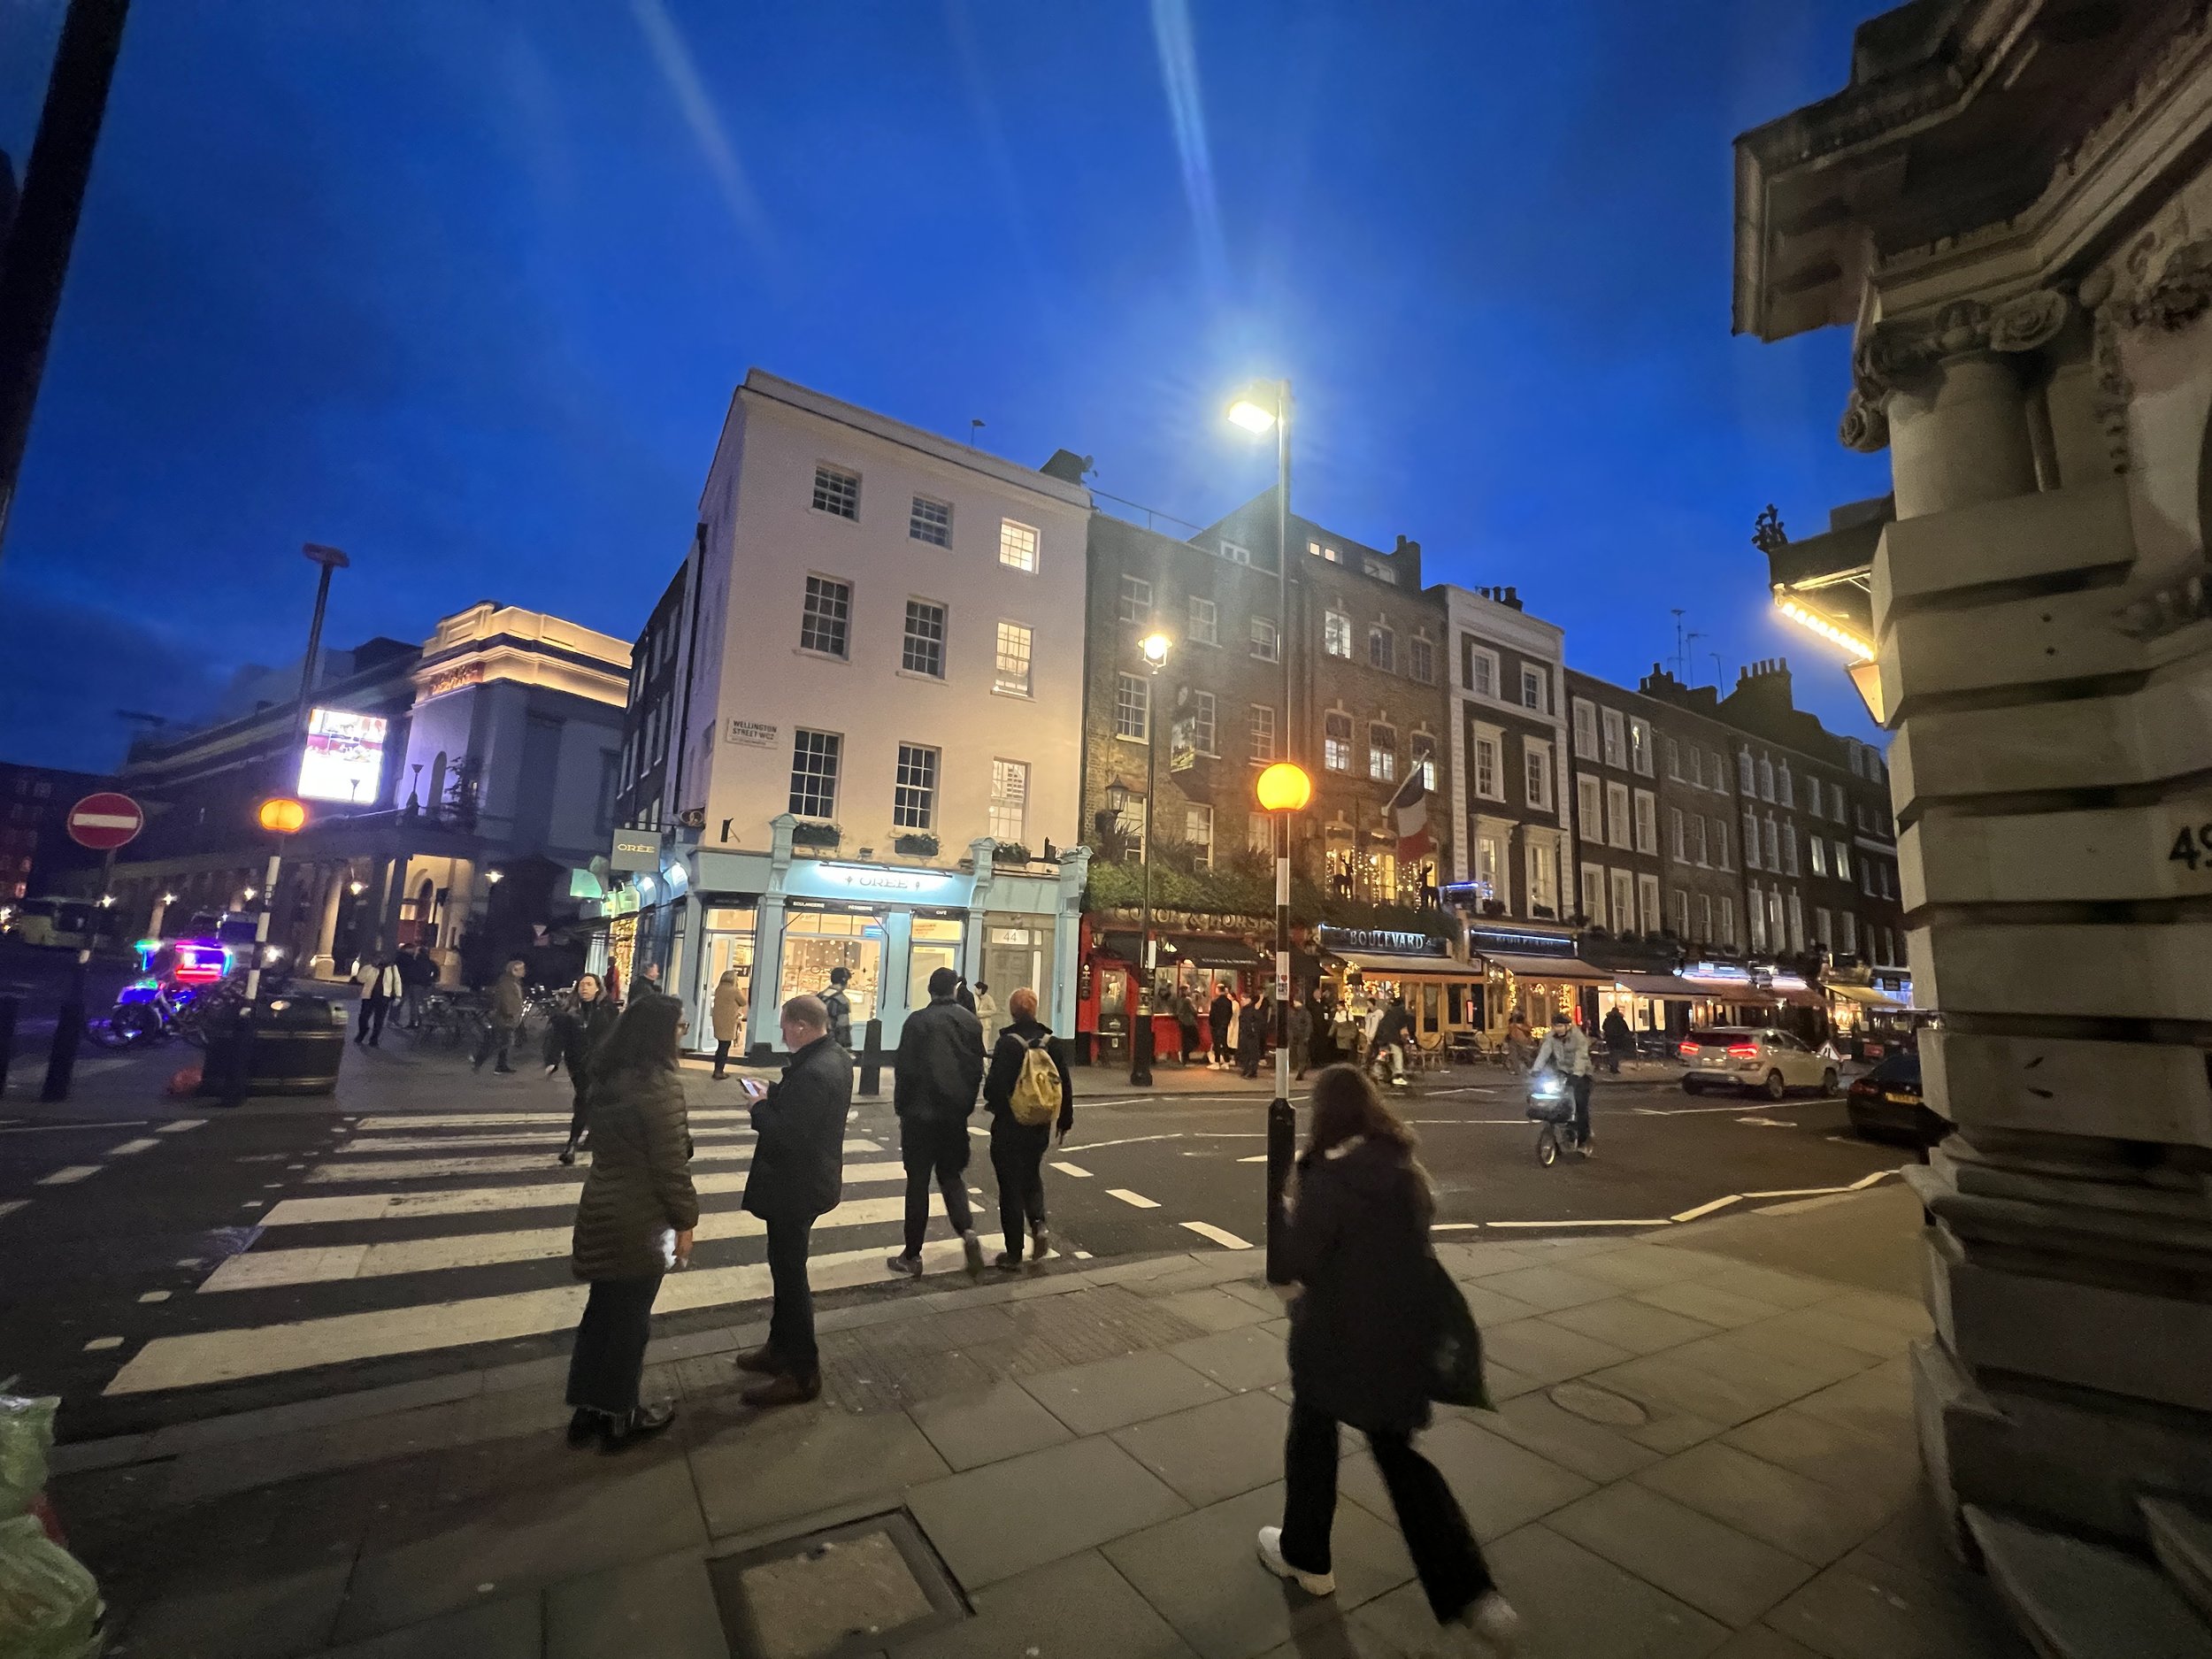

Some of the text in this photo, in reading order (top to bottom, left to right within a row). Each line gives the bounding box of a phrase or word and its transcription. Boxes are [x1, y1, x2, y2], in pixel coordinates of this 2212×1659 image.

[733, 720, 778, 733] WELLINGTON
[733, 727, 758, 738] STREET
[618, 843, 656, 854] ORÉE
[1003, 932, 1018, 942] 44
[1349, 930, 1424, 949] BOULEVARD
